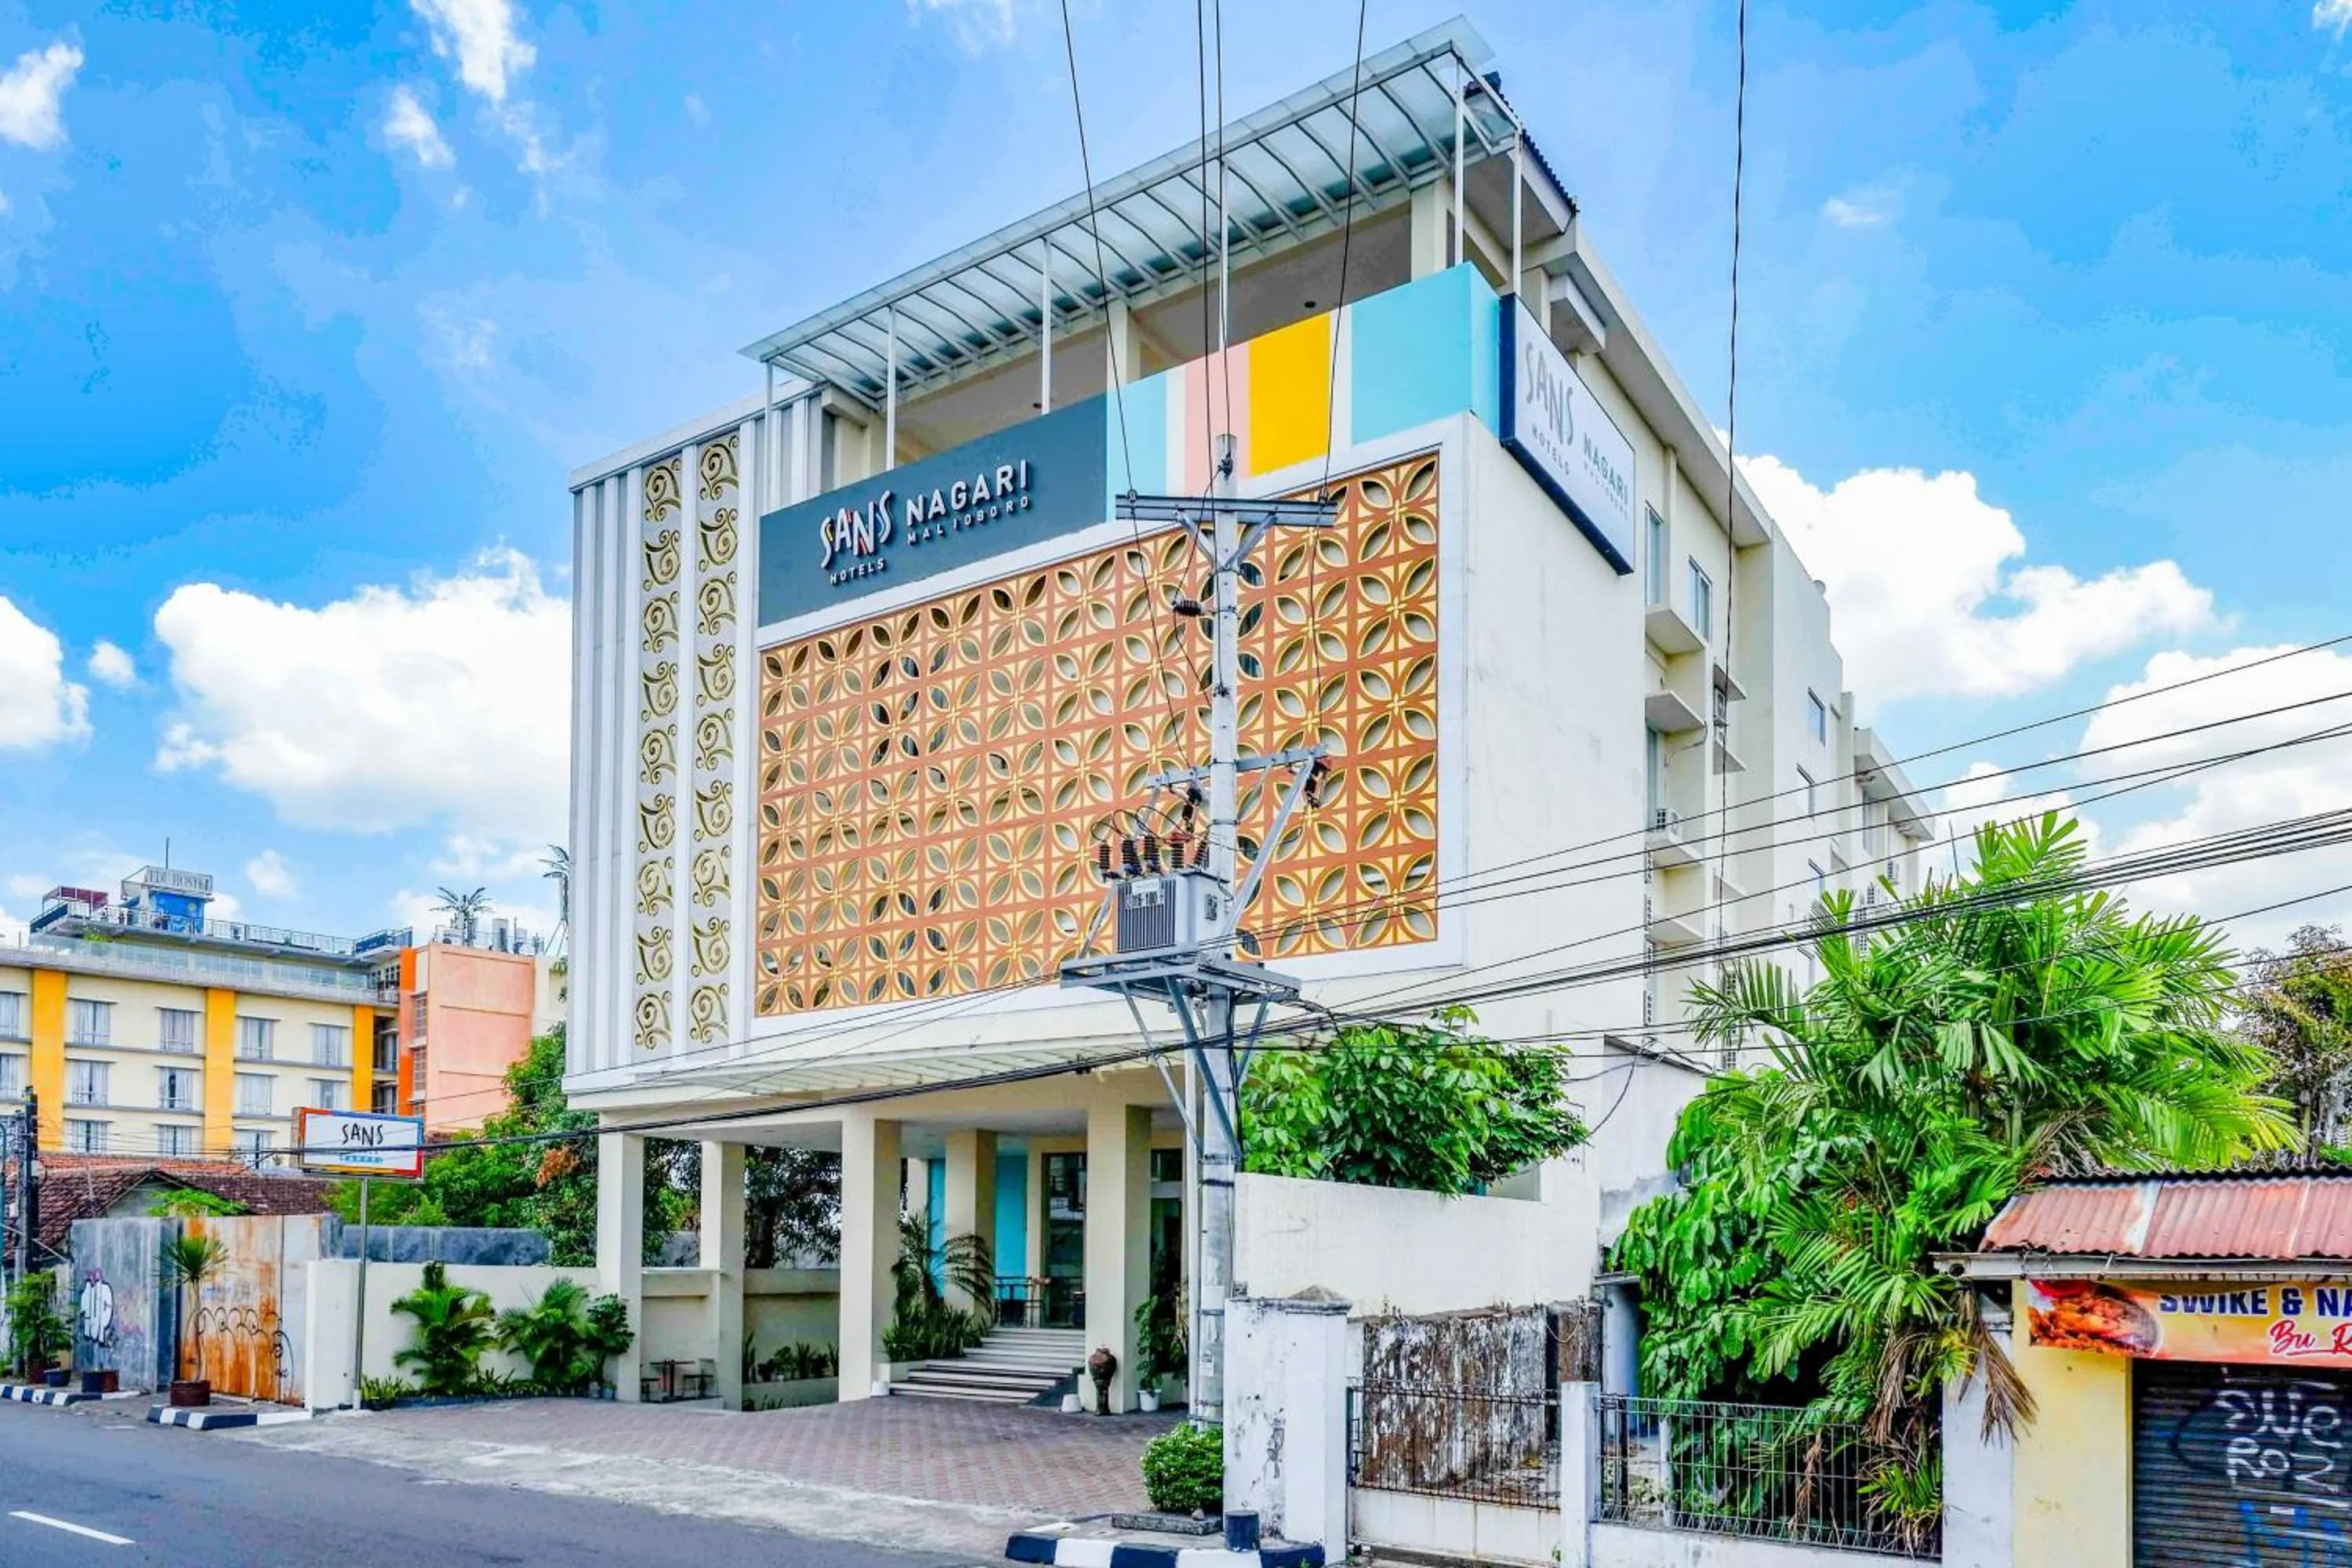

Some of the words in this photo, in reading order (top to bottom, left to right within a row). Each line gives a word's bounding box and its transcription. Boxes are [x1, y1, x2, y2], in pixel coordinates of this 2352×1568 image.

[1526, 342, 1574, 446] SANS
[906, 459, 1029, 527] NAGARI
[1584, 432, 1628, 506] NAGARI
[819, 489, 892, 568] SANS
[907, 495, 1029, 546] MALIOBORO
[830, 557, 886, 585] HOTELS
[342, 1122, 384, 1146] SANS
[2281, 1287, 2303, 1316] &
[2269, 1319, 2316, 1356] Bu
